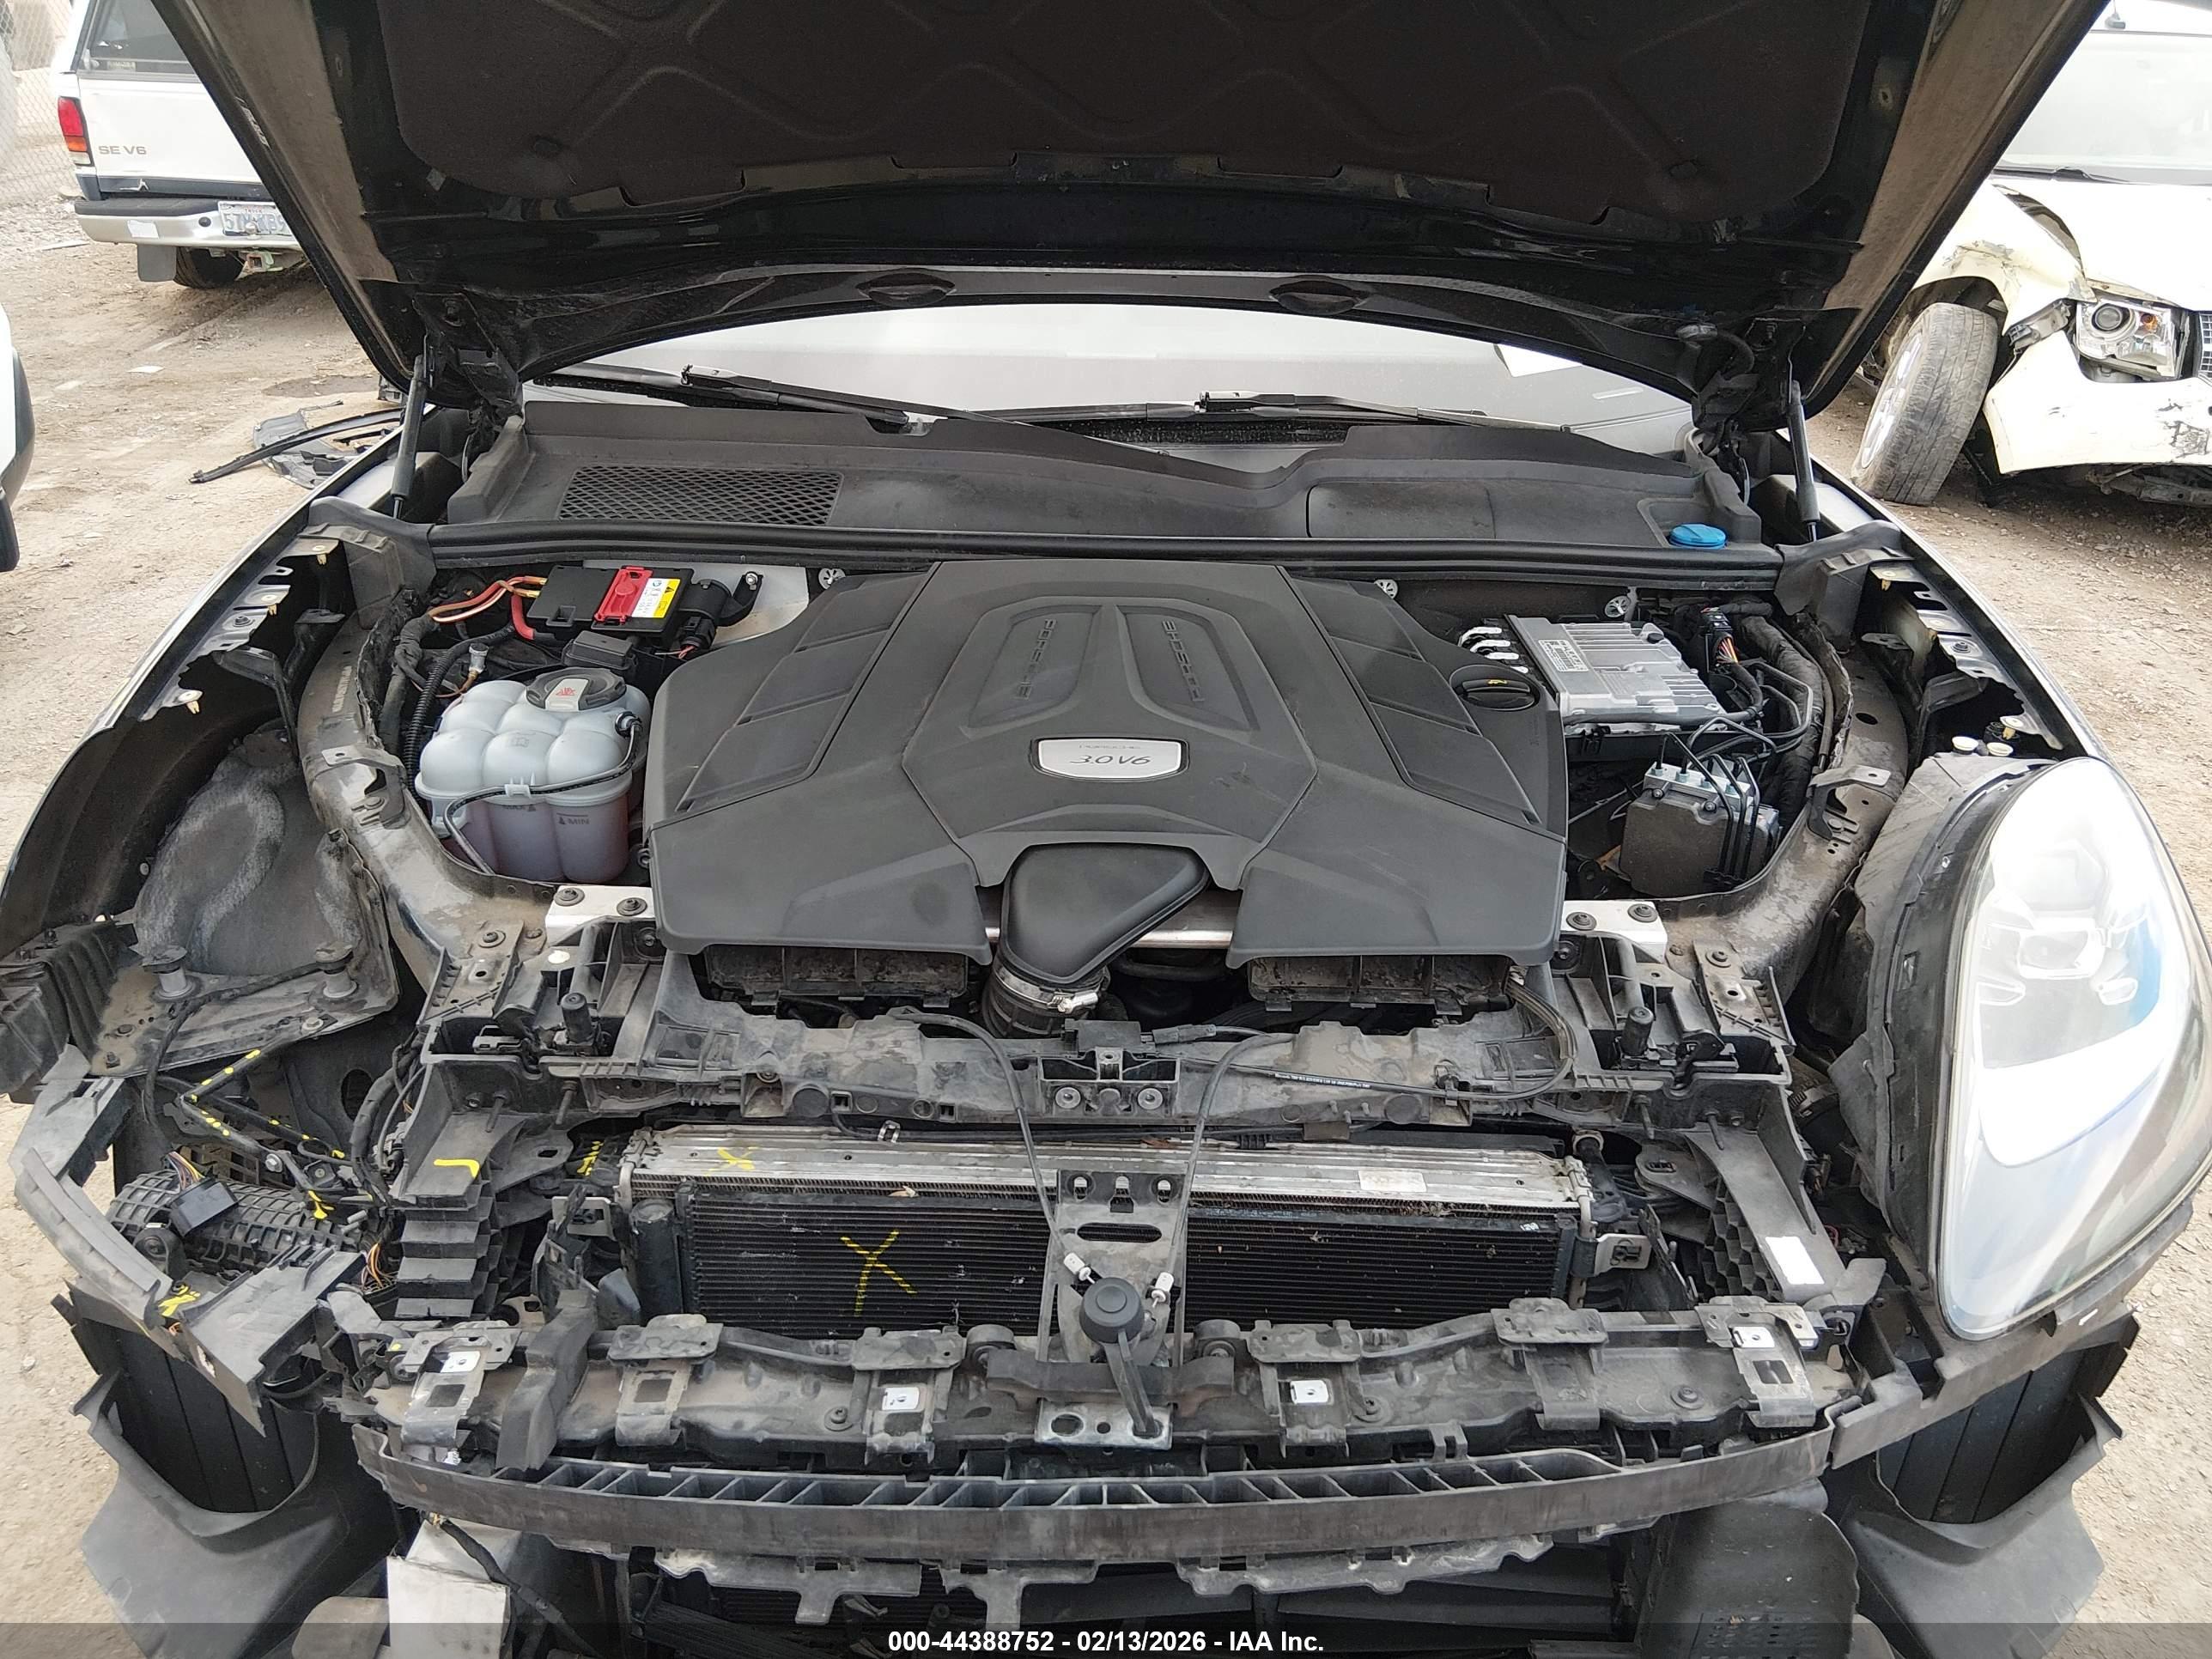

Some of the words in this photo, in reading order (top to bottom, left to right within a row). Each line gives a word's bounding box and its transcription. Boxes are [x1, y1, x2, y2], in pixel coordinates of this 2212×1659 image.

[98, 145, 121, 155] SE
[123, 145, 147, 155] V6
[1161, 619, 1206, 701] PORSCHE
[1070, 755, 1113, 765] 3.0
[1118, 755, 1152, 765] V6
